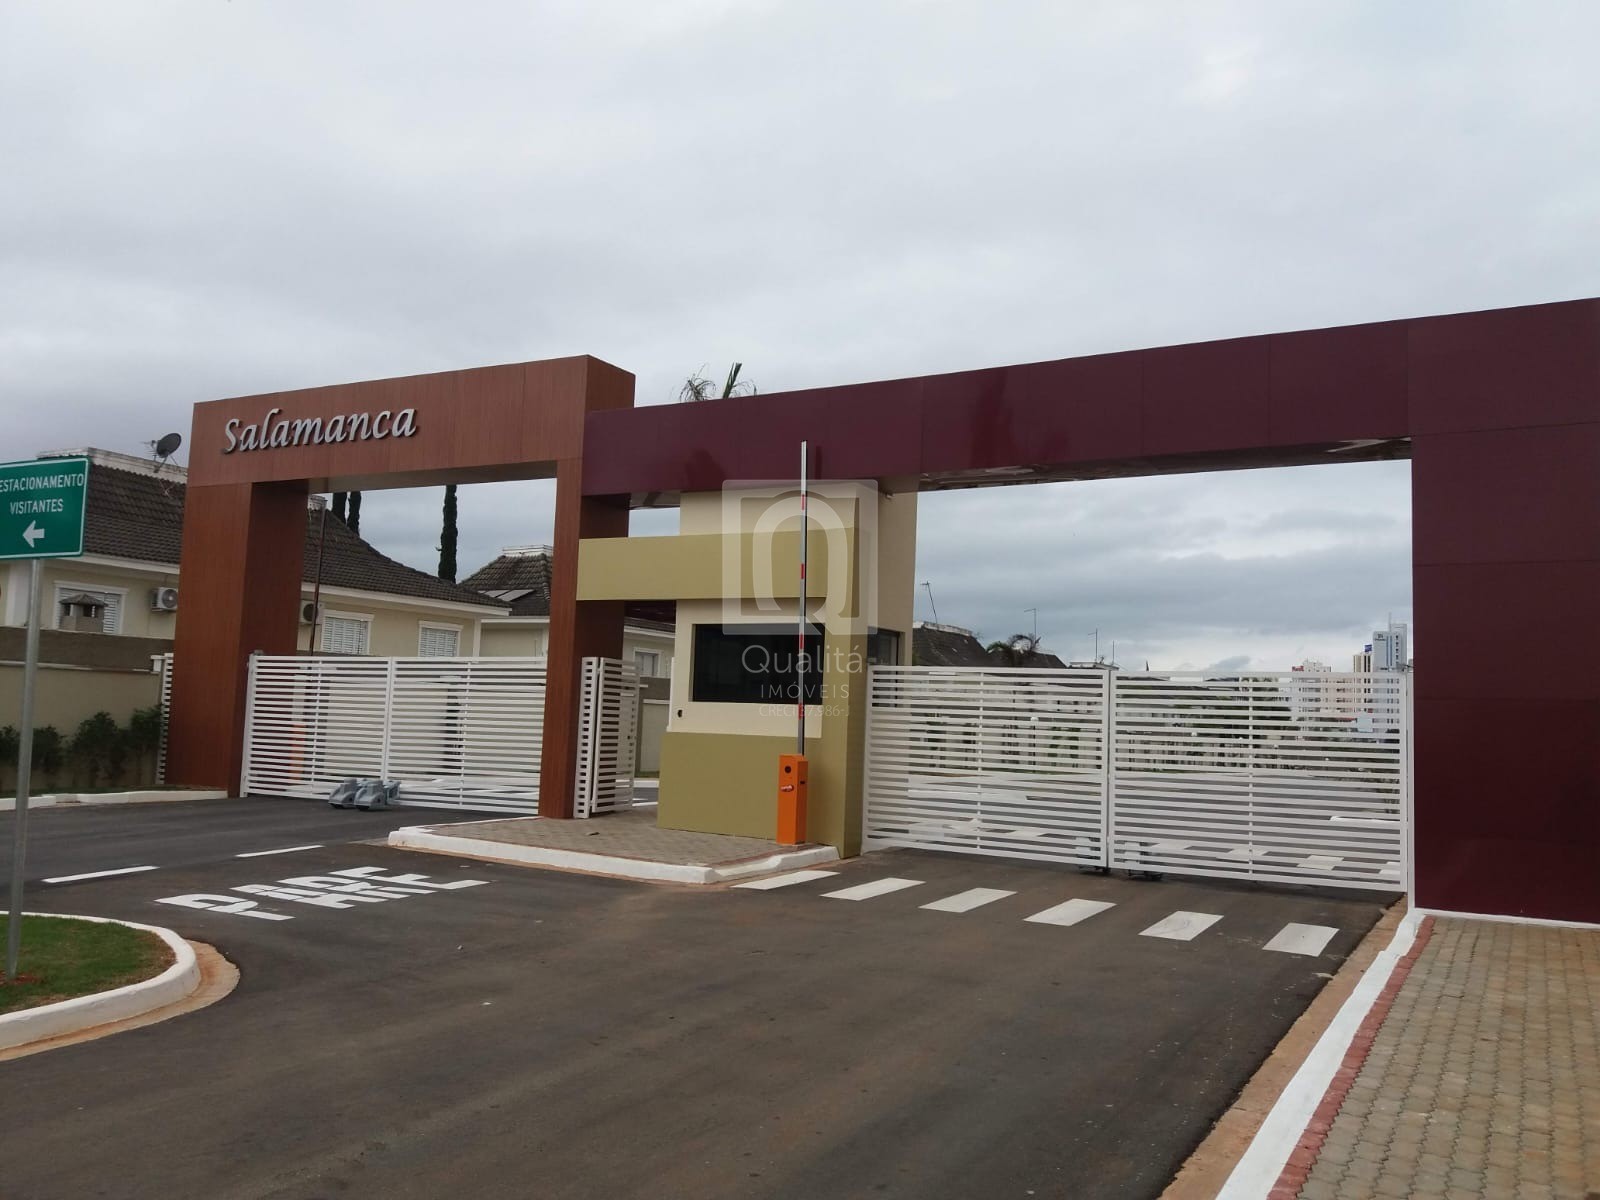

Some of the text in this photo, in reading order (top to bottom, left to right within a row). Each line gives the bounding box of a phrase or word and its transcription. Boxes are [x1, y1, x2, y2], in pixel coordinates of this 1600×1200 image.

[222, 408, 417, 454] Salamanca
[0, 473, 84, 492] ESTACIONAMENTO
[10, 498, 64, 515] VISITANTES
[154, 866, 490, 921] PARE
